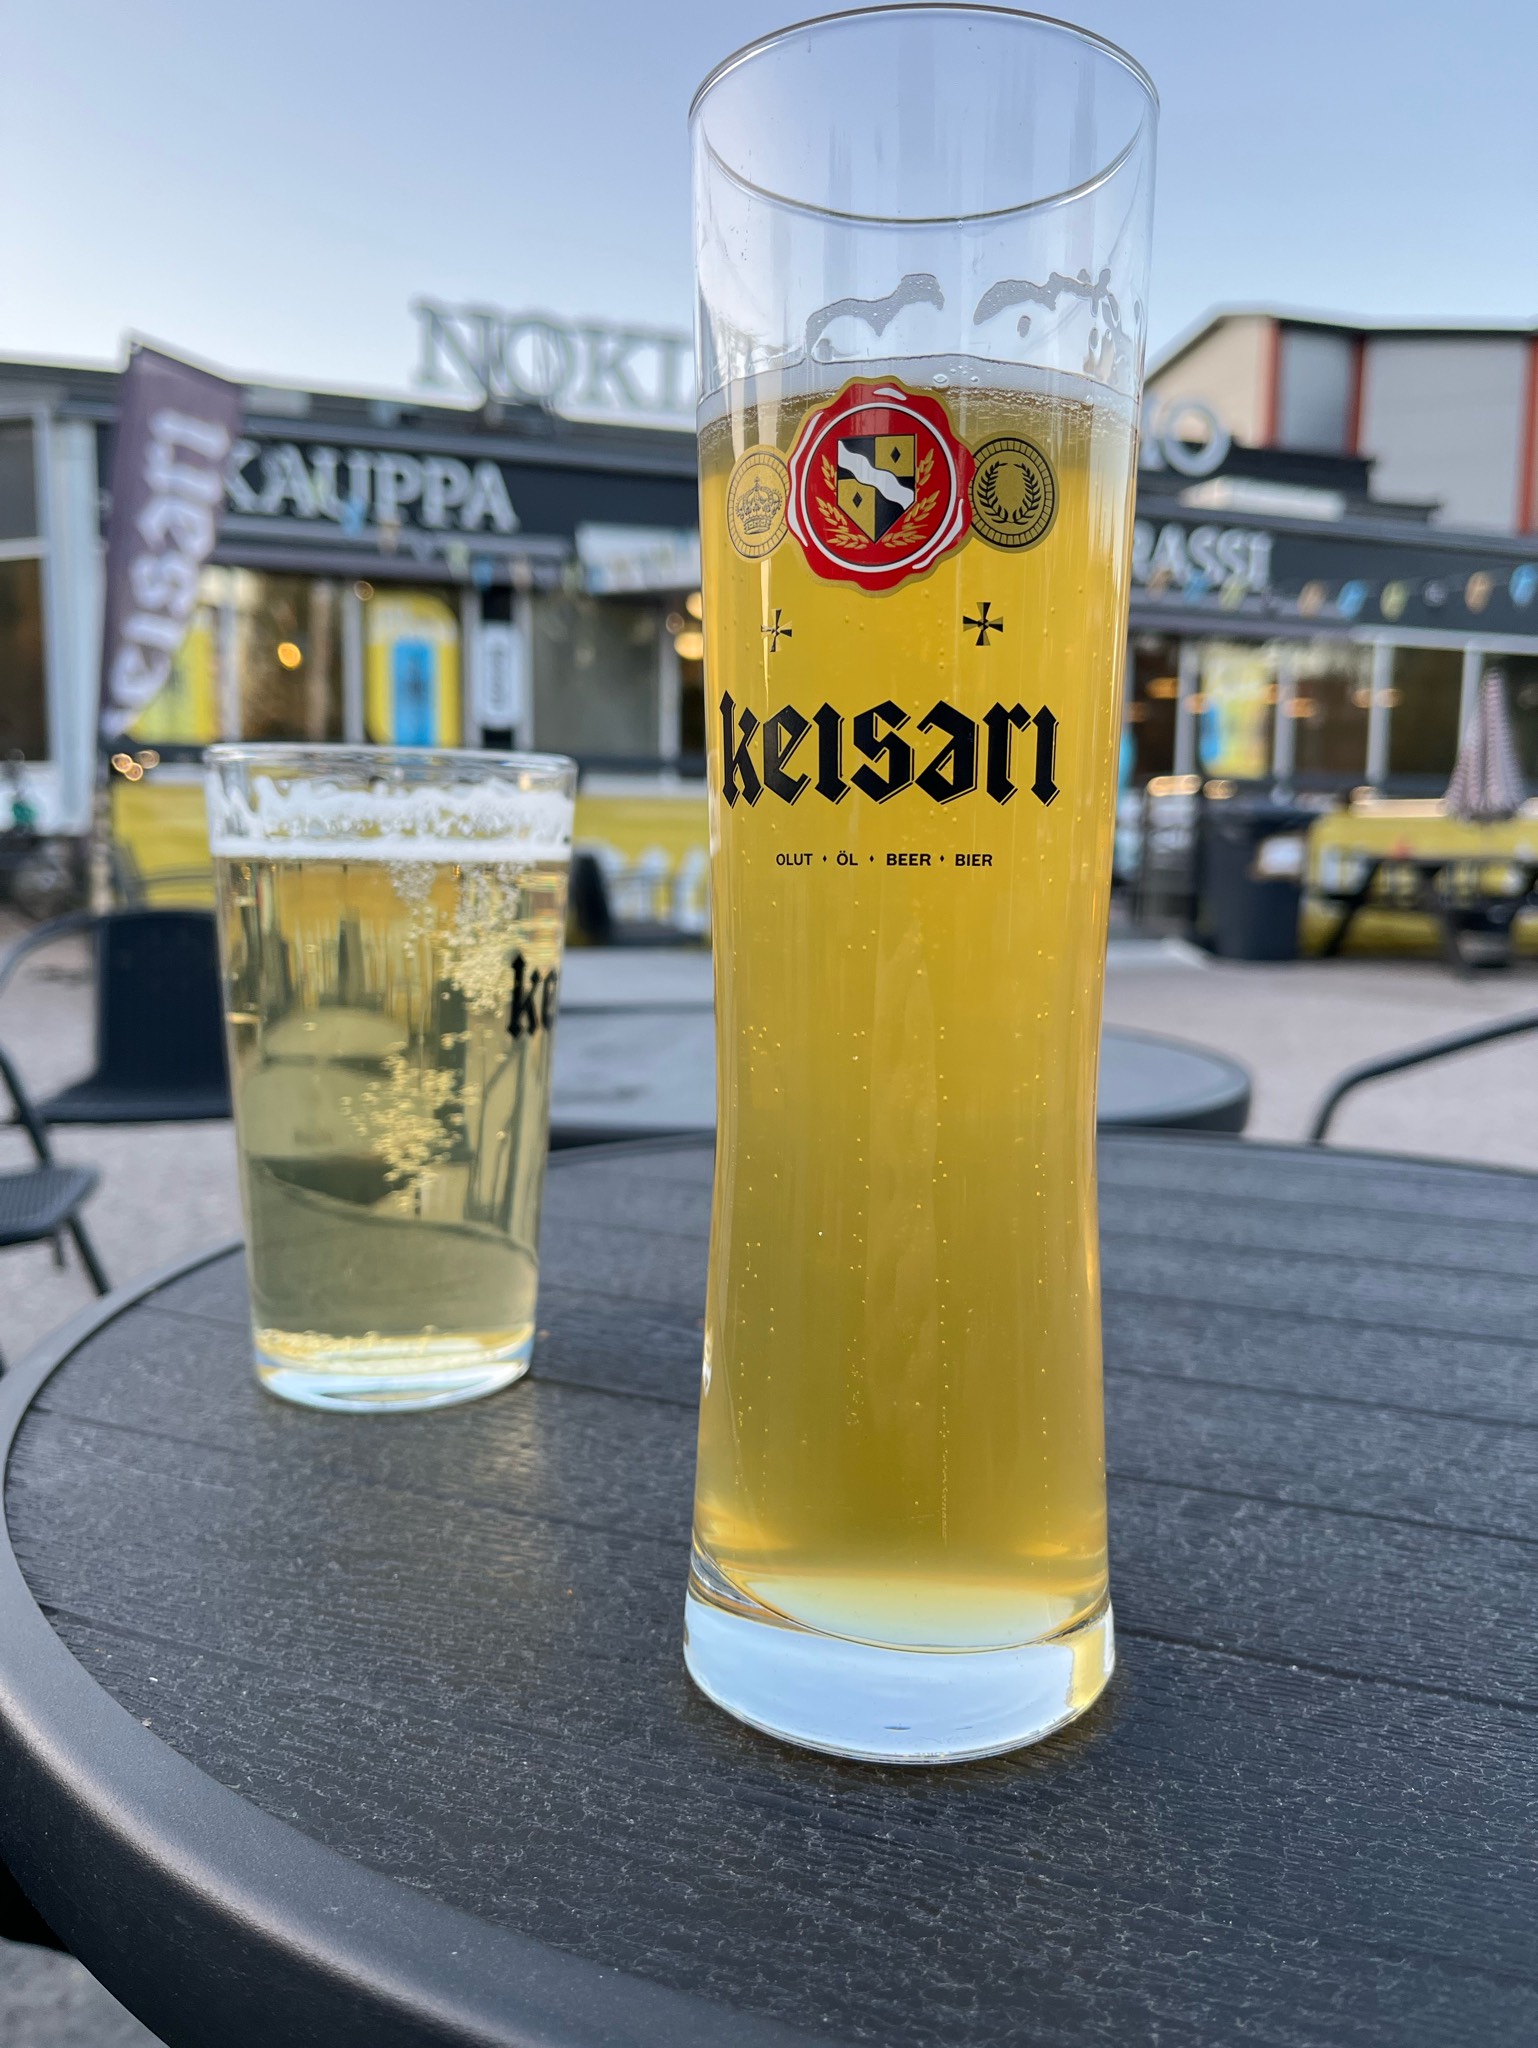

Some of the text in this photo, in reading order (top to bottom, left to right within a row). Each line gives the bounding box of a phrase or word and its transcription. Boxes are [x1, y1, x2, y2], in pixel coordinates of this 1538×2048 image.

[225, 438, 518, 533] KAUPPA
[720, 690, 1059, 808] keisari
[775, 850, 993, 867] OLUT ÖL BEER BIER
